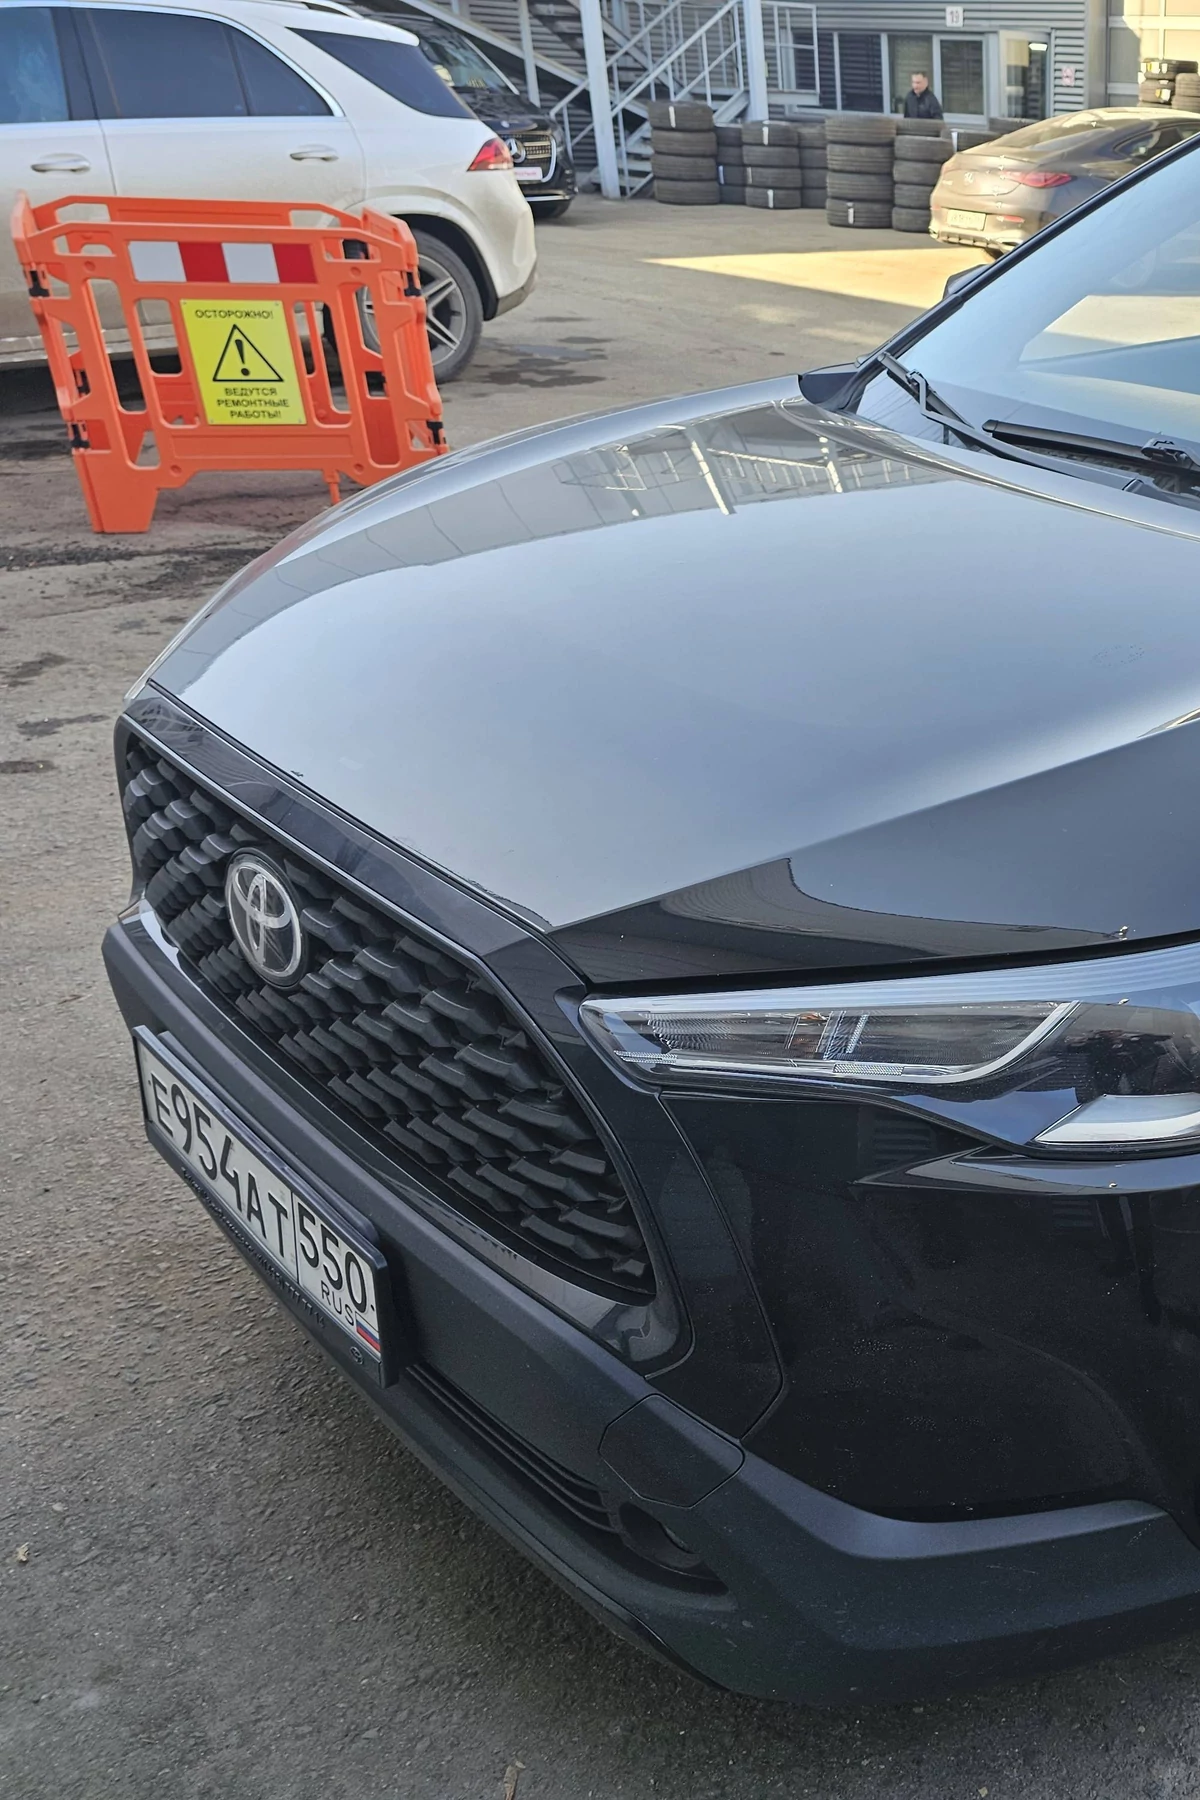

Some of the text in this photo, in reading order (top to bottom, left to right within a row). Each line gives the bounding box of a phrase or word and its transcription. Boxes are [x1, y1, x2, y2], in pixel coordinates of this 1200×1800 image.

[195, 309, 274, 319] ОСТОРОЖНО!
[224, 387, 278, 397] ВЕДУТСЯ
[216, 398, 290, 408] РЕМОНТНЫЕ
[297, 1201, 368, 1314] 550
[320, 1279, 355, 1327] RUS
